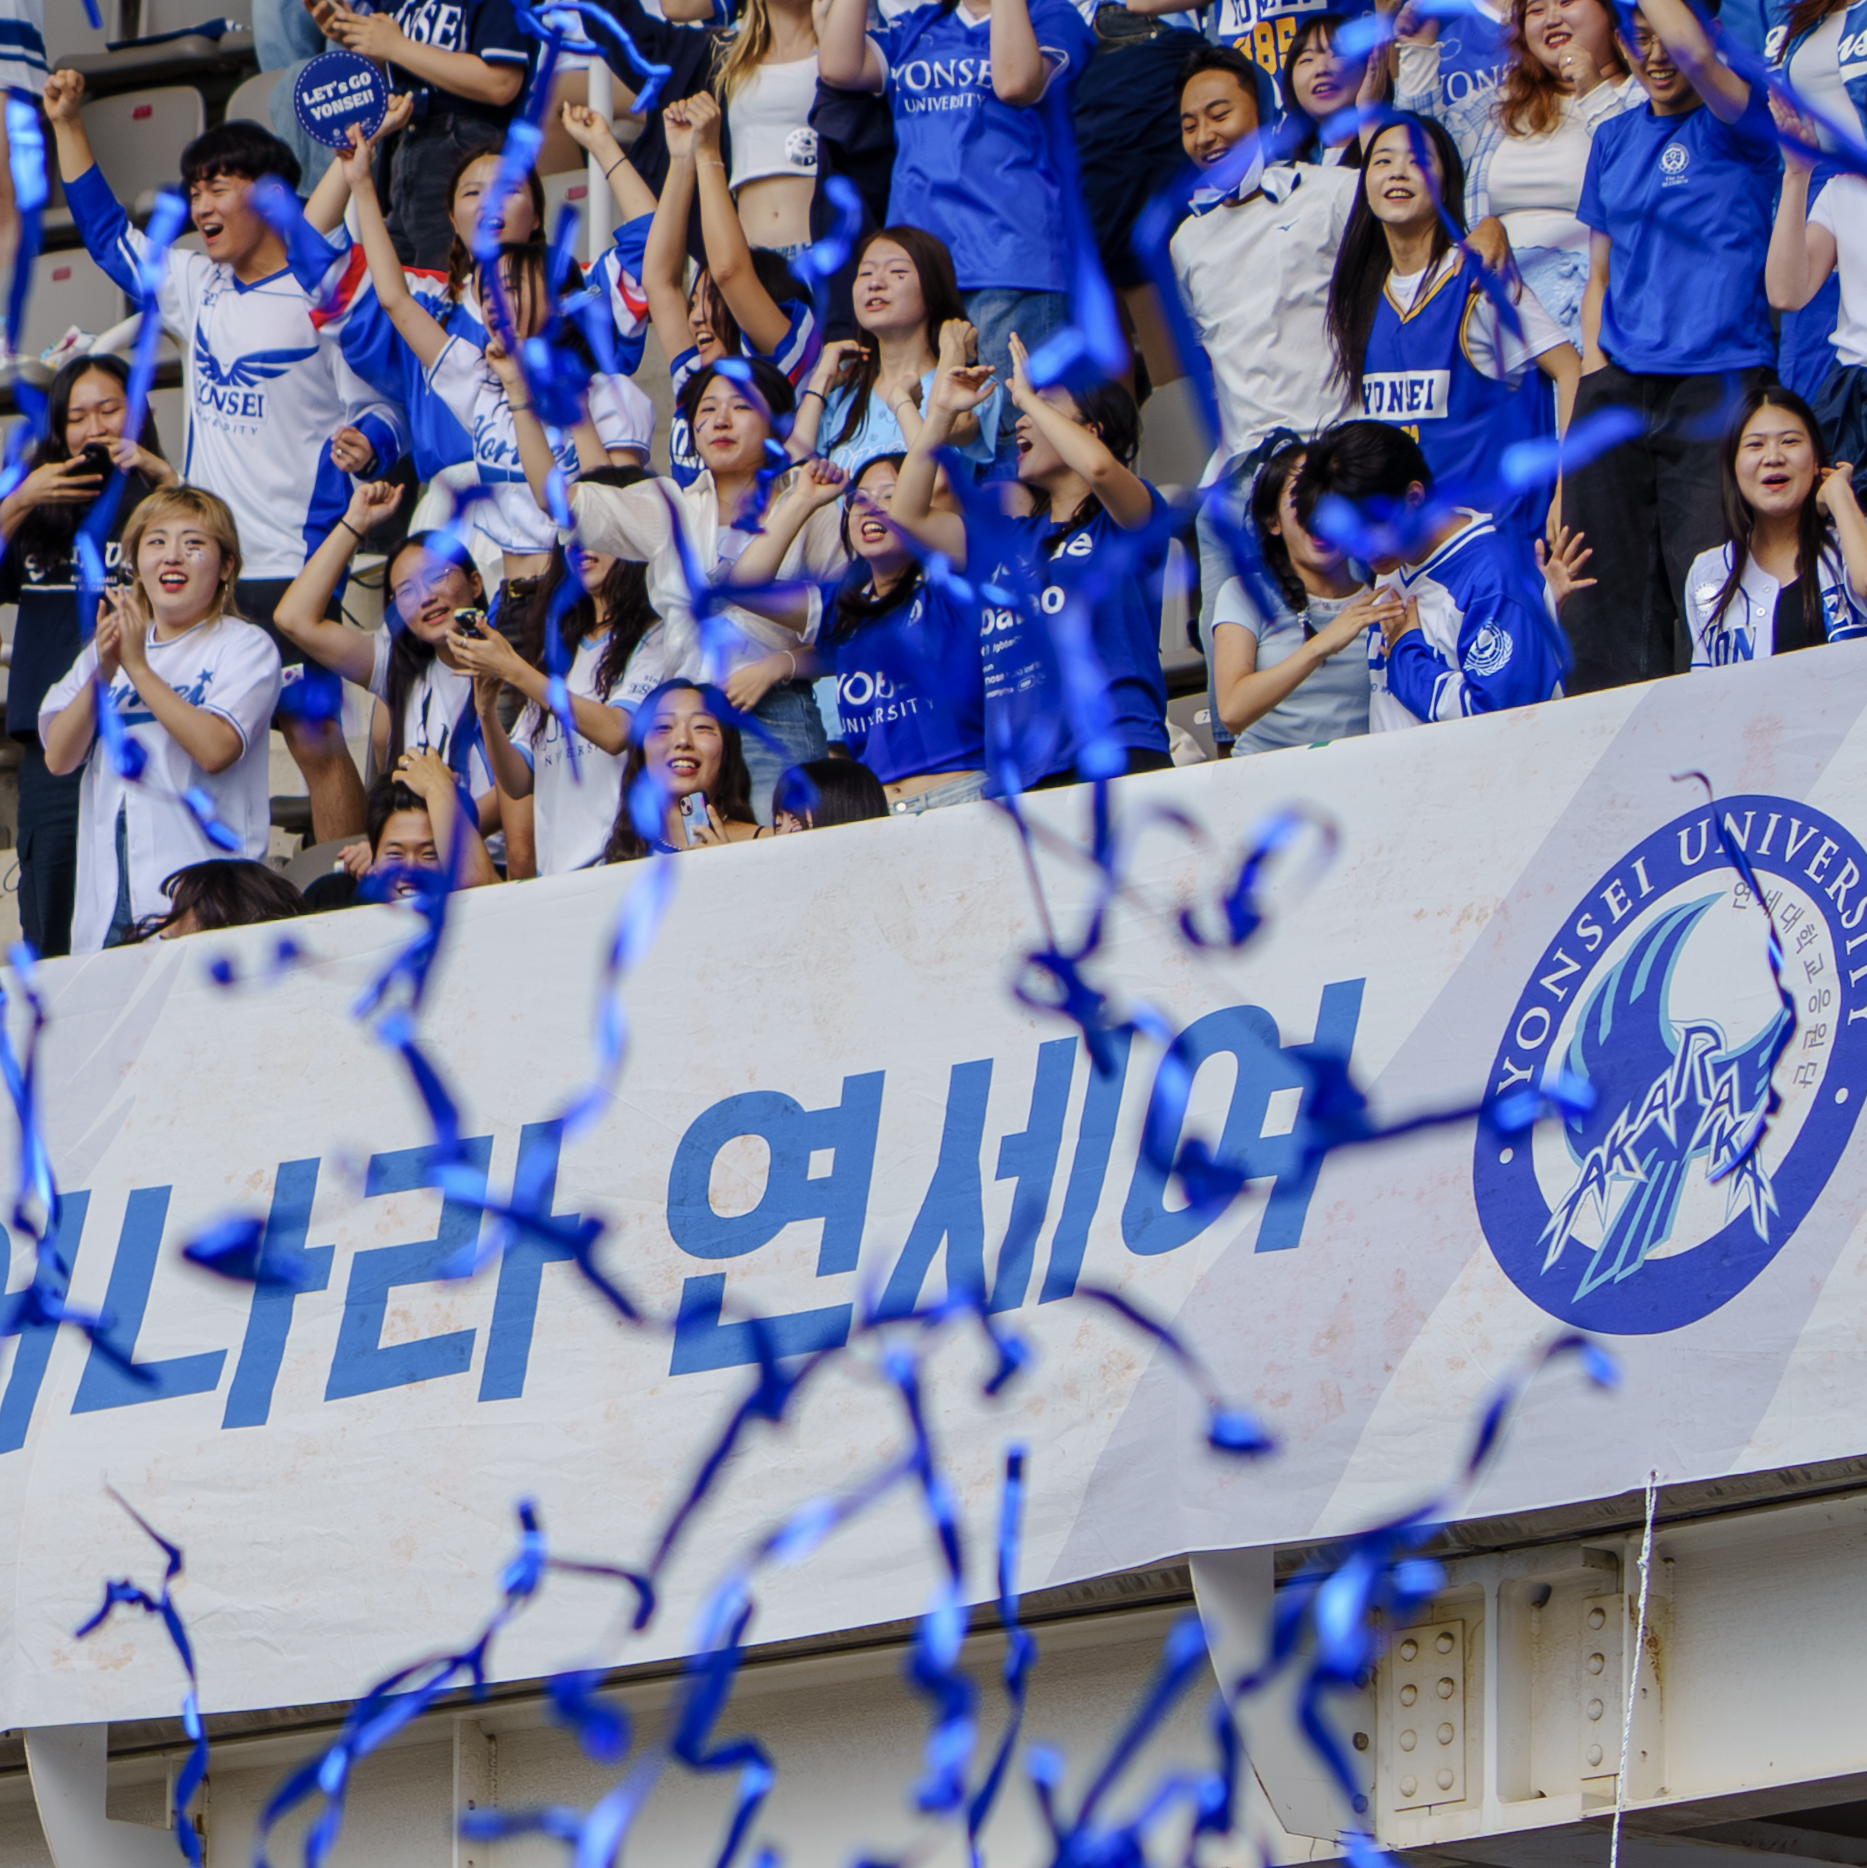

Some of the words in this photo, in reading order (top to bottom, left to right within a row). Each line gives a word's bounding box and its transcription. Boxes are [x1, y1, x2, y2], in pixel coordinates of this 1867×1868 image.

[303, 79, 347, 107] LET's
[349, 70, 372, 90] GO
[310, 86, 374, 121] YONSEI!!
[1495, 854, 1656, 1098] YONSEI
[666, 976, 1366, 1378] 연세여
